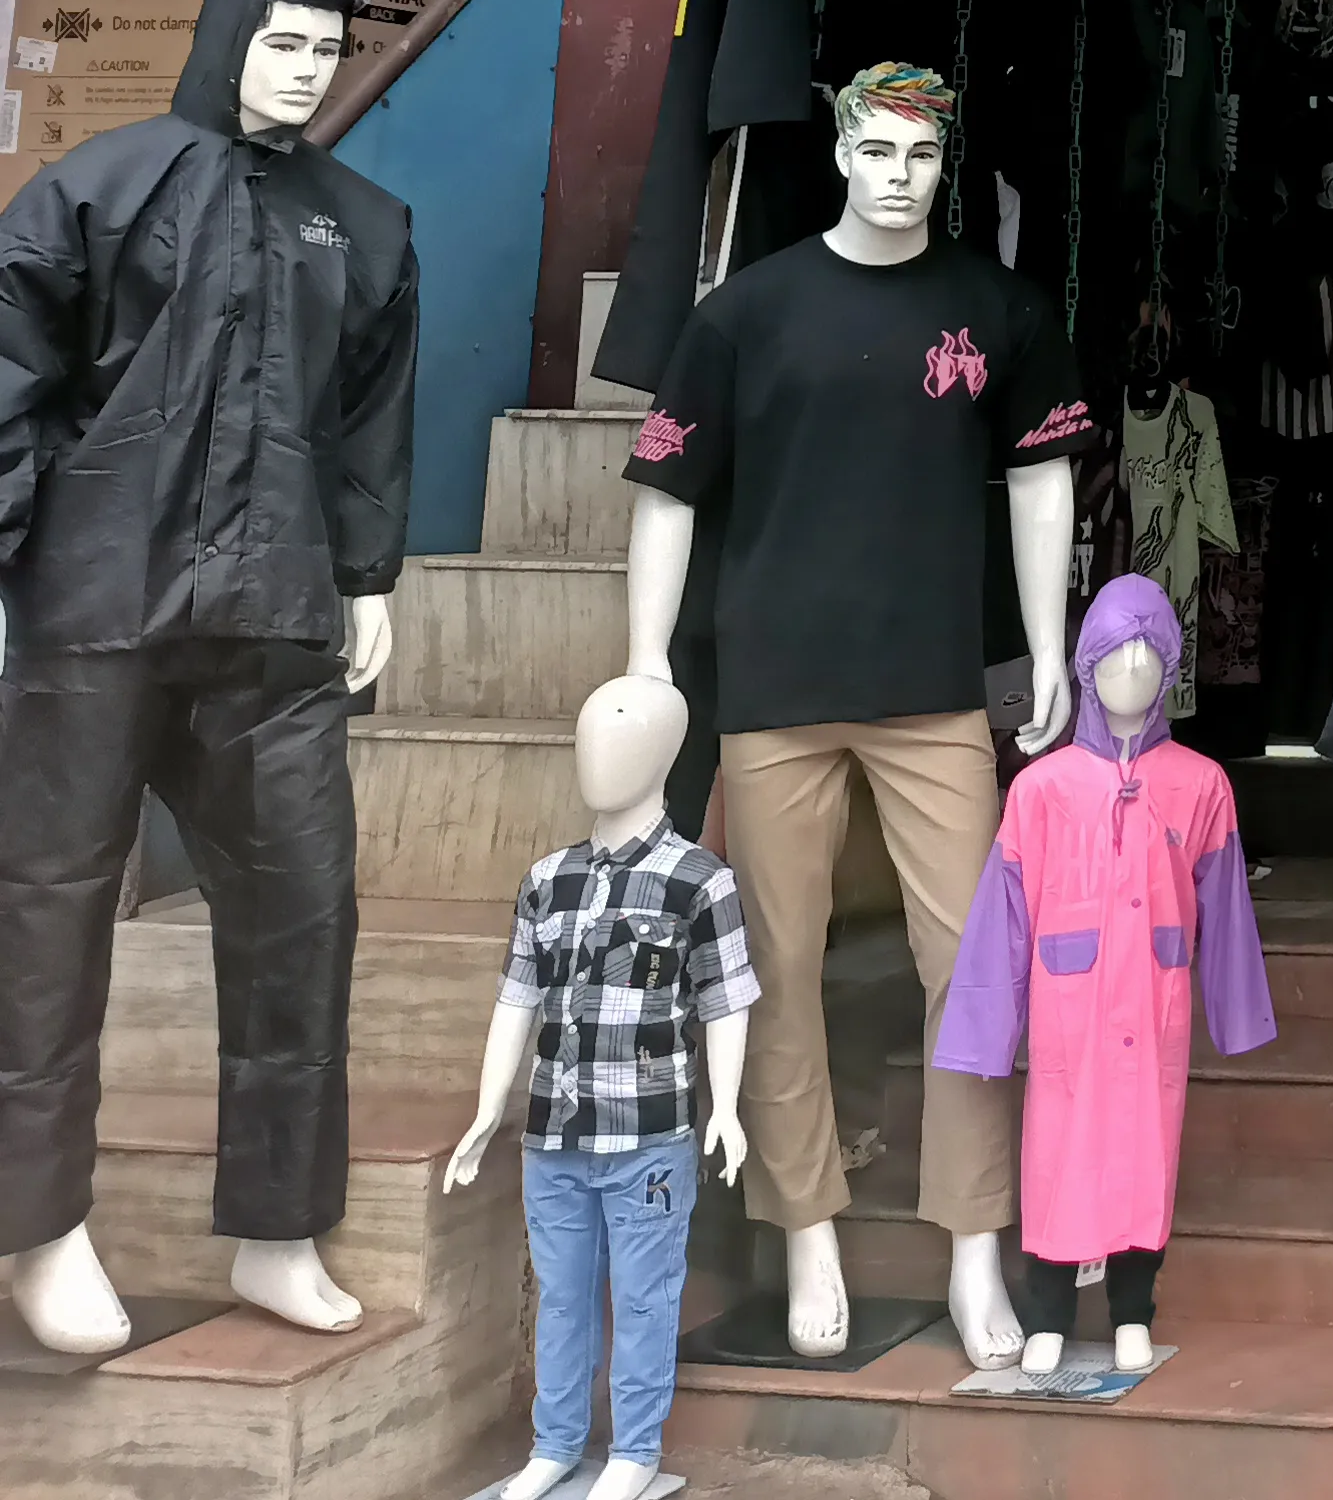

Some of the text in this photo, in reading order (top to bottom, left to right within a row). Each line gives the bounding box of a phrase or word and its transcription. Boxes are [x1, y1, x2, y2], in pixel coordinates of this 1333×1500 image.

[369, 7, 396, 22] BACK
[112, 16, 131, 31] Do
[134, 16, 157, 31] not
[101, 61, 150, 72] CAUTION
